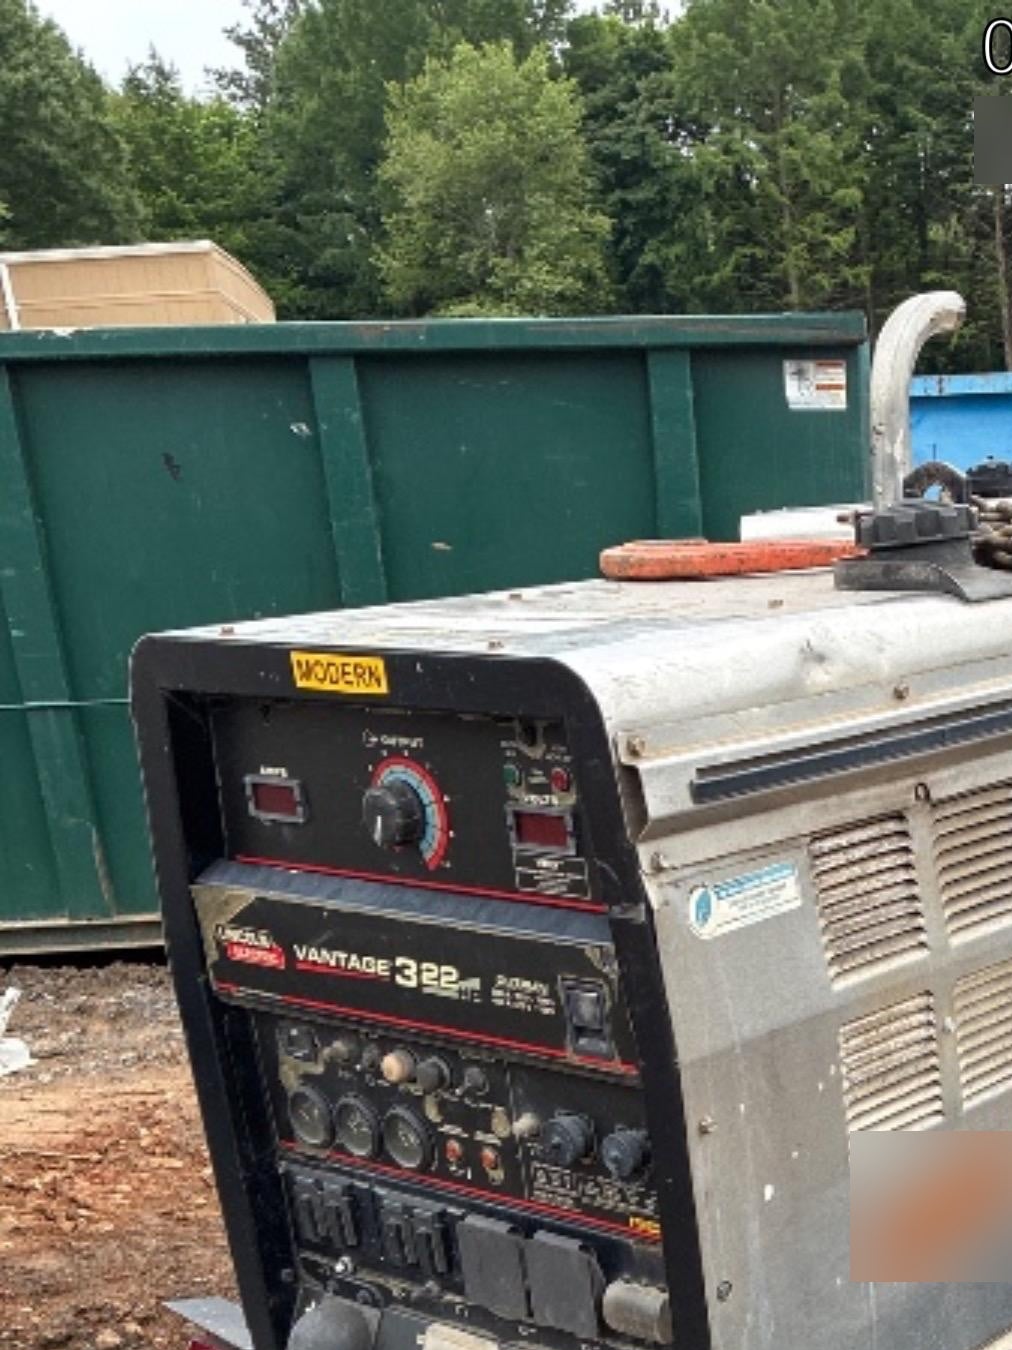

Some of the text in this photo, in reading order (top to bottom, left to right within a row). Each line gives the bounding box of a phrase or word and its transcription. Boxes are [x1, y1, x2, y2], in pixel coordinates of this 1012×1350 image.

[296, 658, 382, 688] MODERN
[293, 944, 391, 976] VANTAGE
[395, 956, 459, 991] 322
